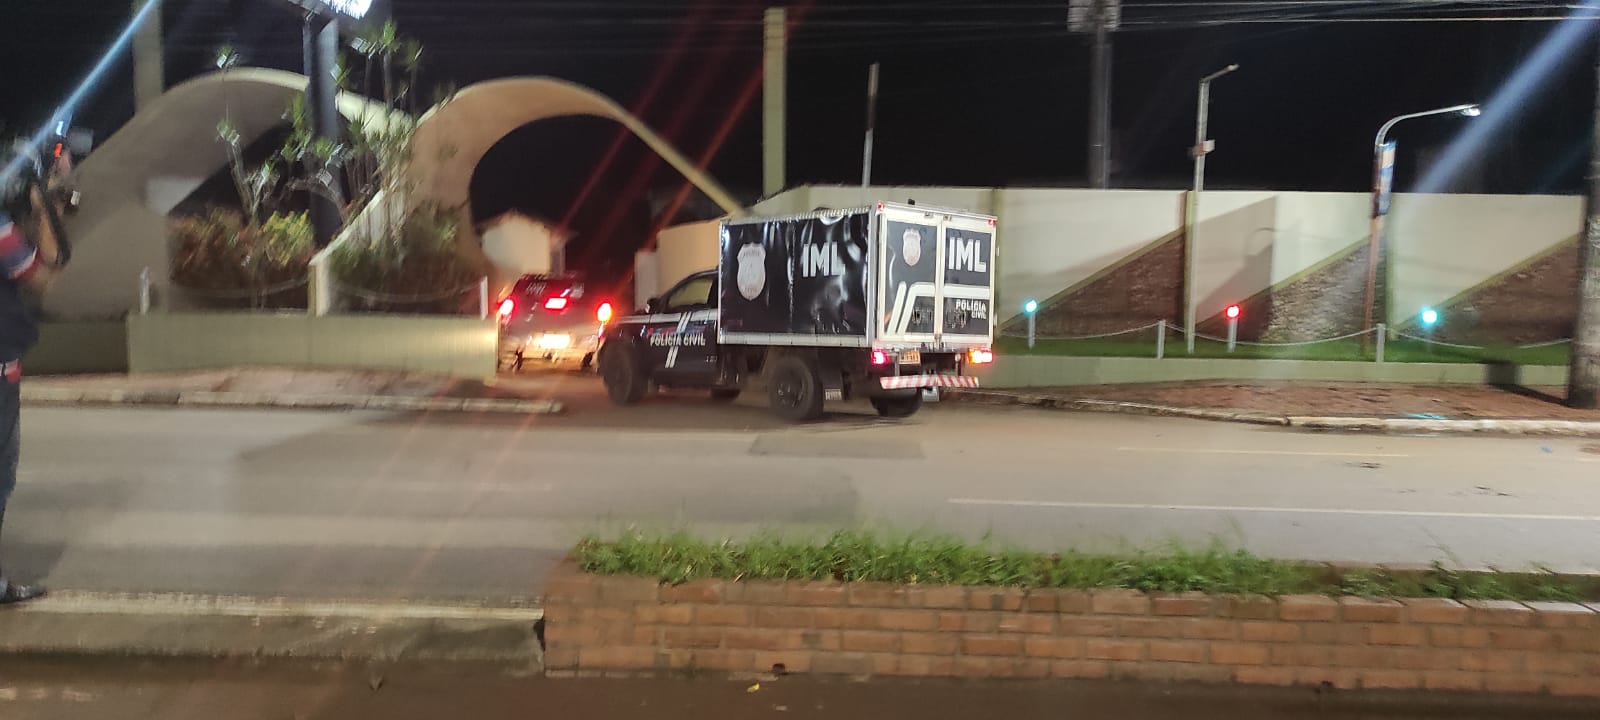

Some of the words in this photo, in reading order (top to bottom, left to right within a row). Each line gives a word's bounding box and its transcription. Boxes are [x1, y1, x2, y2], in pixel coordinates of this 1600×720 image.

[802, 242, 846, 278] IML
[948, 237, 987, 273] IML
[971, 310, 987, 320] CIVIL
[683, 332, 706, 347] CIVIL
